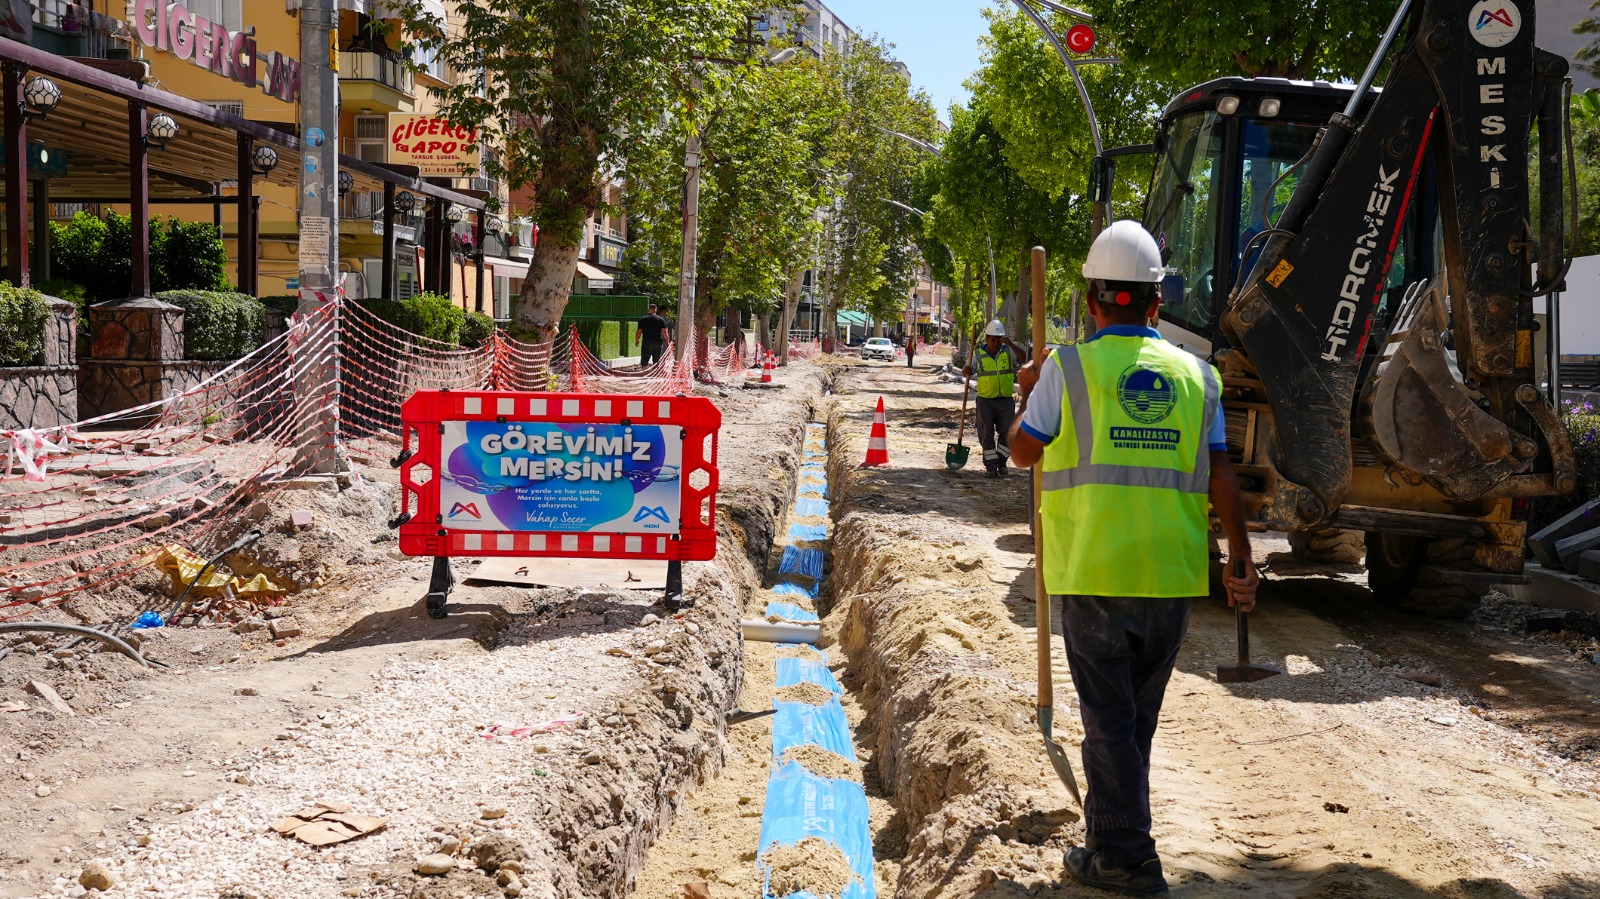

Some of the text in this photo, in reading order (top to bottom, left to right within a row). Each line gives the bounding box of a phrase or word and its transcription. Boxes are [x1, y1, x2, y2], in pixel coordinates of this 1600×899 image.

[411, 141, 458, 154] APO
[480, 424, 651, 461] GÖREVİMİZ
[500, 456, 623, 482] MERSİN!
[580, 495, 600, 503] başla
[526, 510, 558, 528] Vahap
